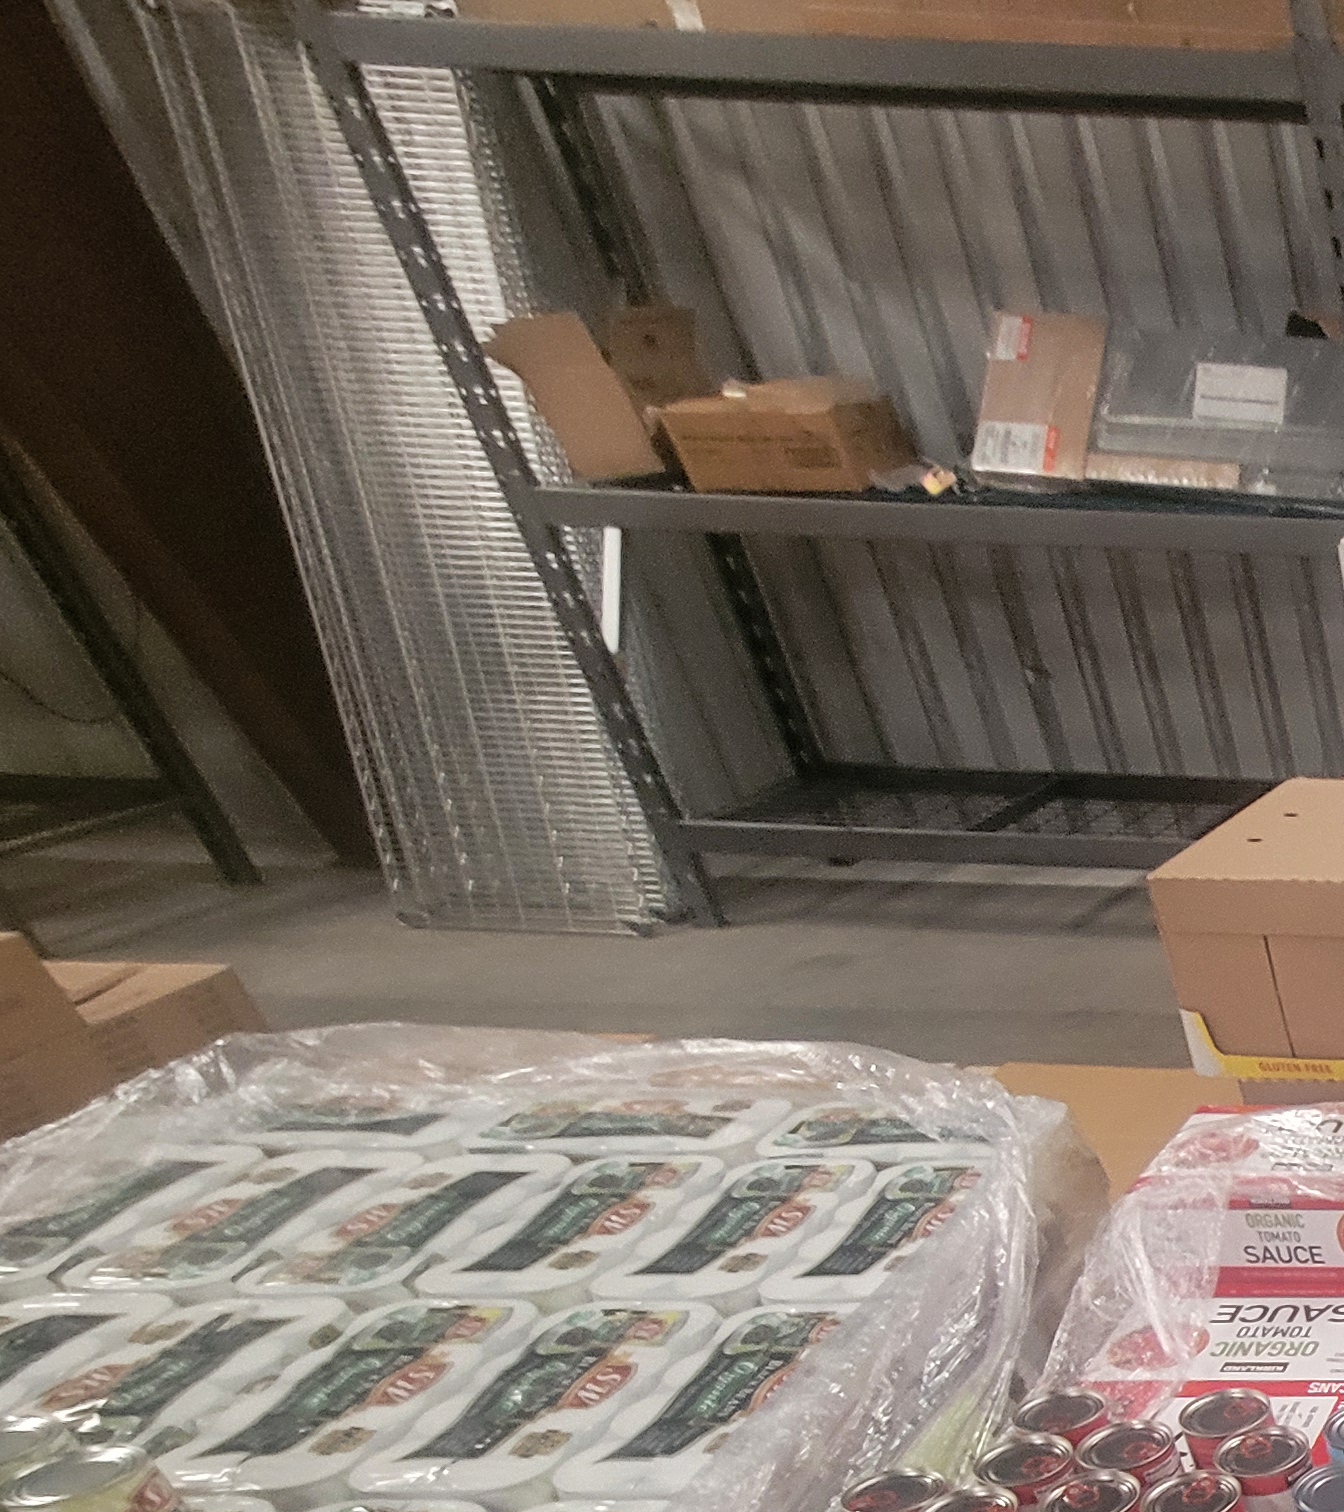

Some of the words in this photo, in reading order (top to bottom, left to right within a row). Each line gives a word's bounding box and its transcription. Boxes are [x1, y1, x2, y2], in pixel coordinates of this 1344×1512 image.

[1245, 1212, 1306, 1230] ORGANIC
[1256, 1230, 1302, 1244] TOMATO
[1243, 1245, 1326, 1265] SAUCE
[1237, 1326, 1314, 1339] TOMATO
[1210, 1340, 1319, 1358] ORGANIC
